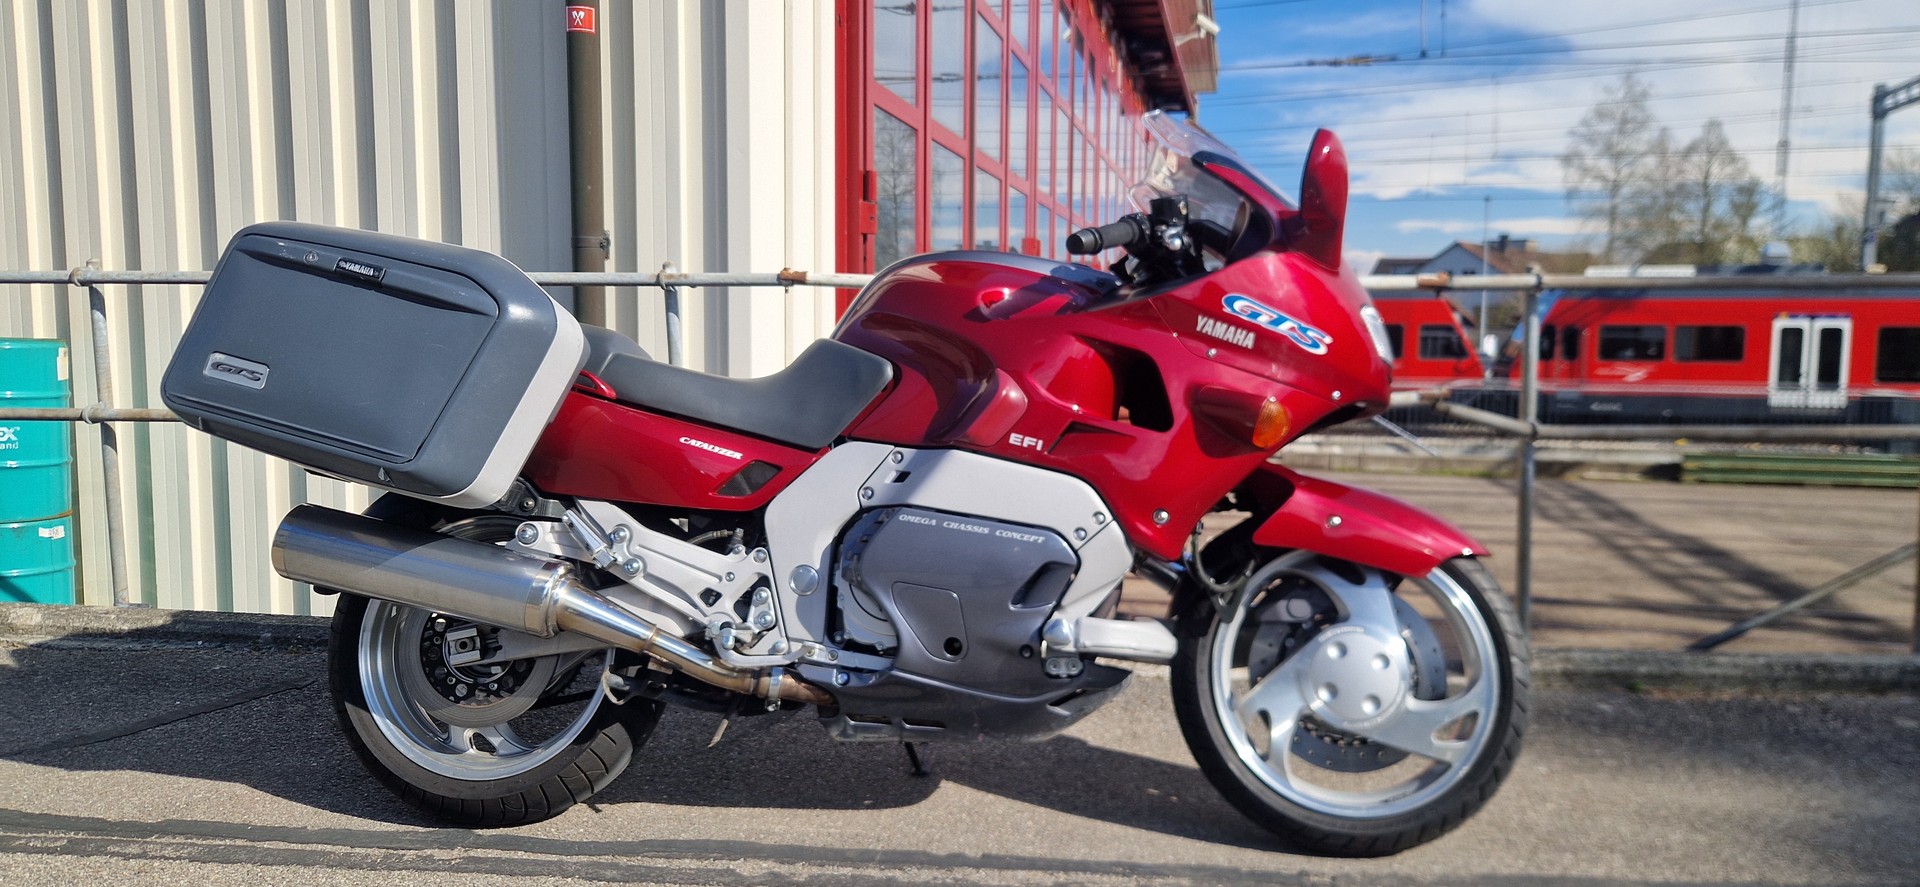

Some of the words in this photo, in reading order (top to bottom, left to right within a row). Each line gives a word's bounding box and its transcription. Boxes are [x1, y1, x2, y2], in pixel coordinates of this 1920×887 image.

[345, 261, 374, 276] YAMAHA
[1196, 314, 1256, 350] YAMAHA
[1222, 293, 1334, 356] GTS
[210, 361, 264, 382] GTS
[679, 436, 743, 460] CATALYZER
[1008, 432, 1043, 451] EFI
[899, 513, 936, 526] OMEGA
[943, 520, 990, 534] CHASSIS
[995, 529, 1045, 544] CONCEPT
